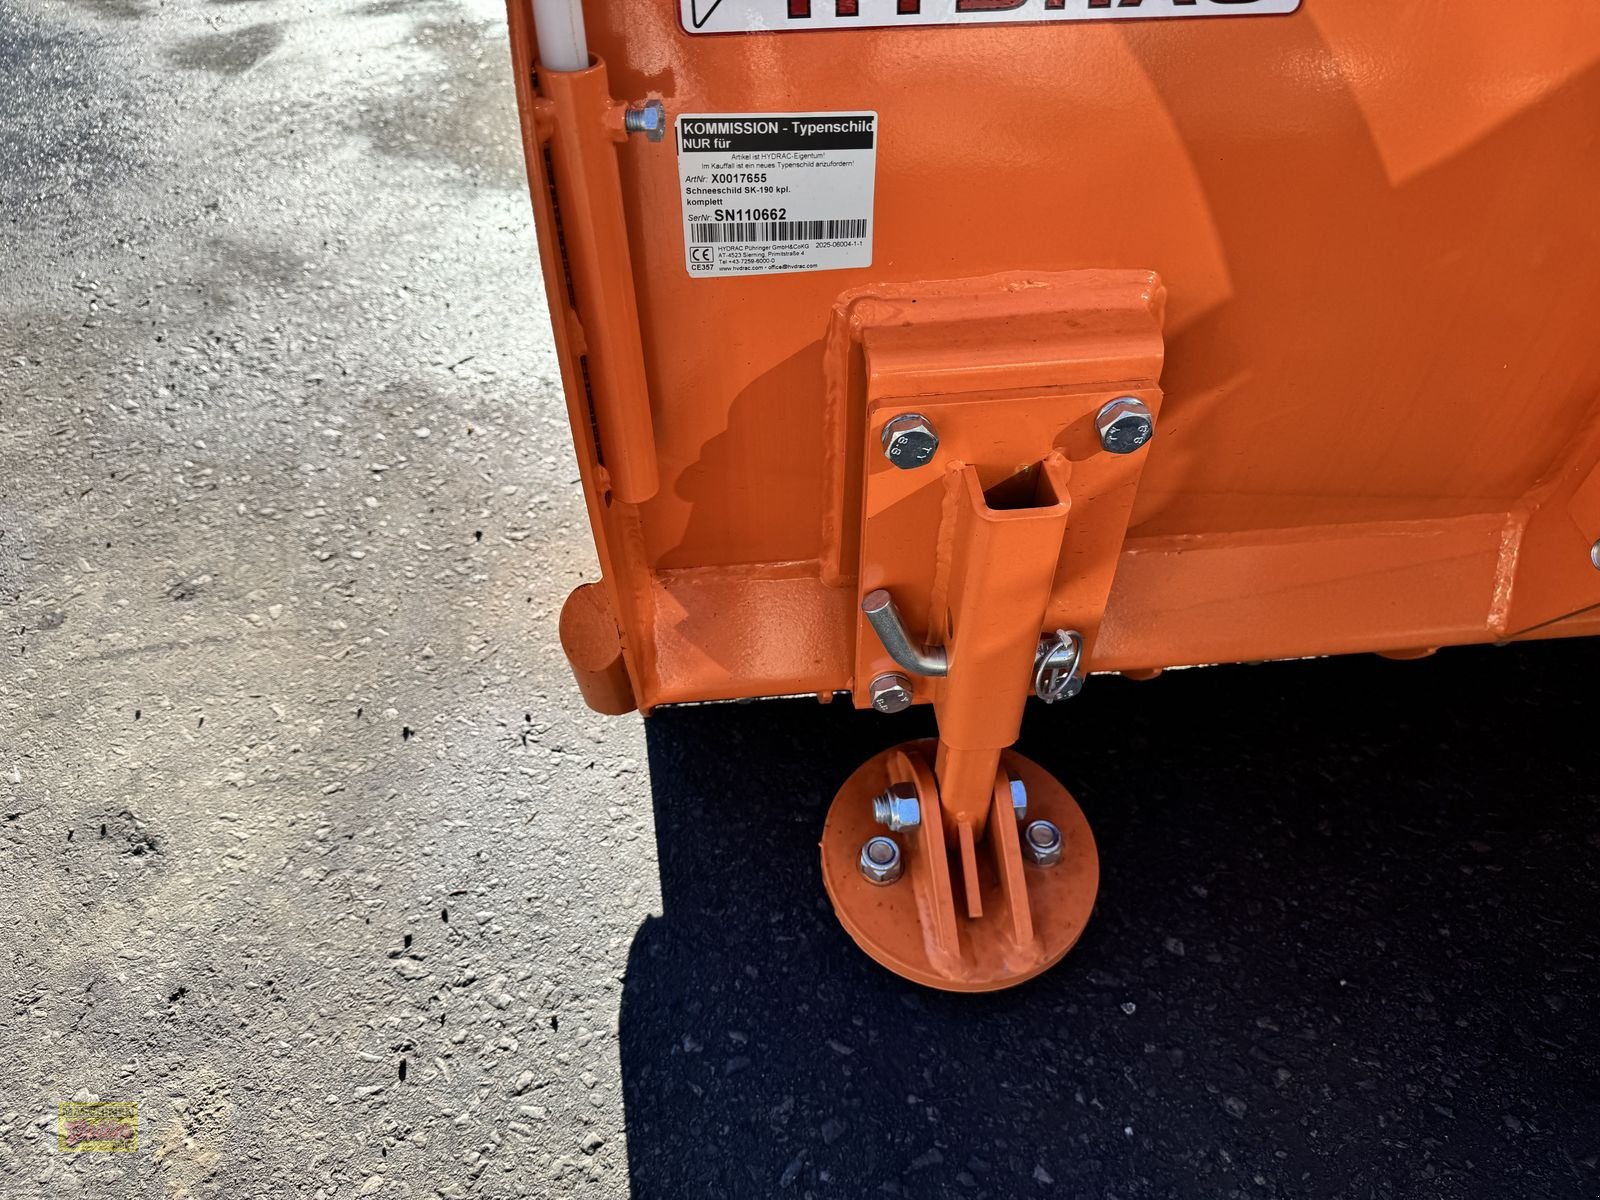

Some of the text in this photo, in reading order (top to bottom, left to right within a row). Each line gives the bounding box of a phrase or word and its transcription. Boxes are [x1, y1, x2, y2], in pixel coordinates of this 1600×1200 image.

[684, 122, 778, 135] KOMMISSION
[683, 138, 732, 149] NUR für
[761, 152, 826, 160] HYDRAC-Eigentum!
[777, 161, 814, 170] Typenschild
[711, 173, 767, 184] X0017655
[776, 186, 791, 194] kpl.
[686, 198, 723, 208] komplett
[688, 208, 787, 222] SerNr: SN110662
